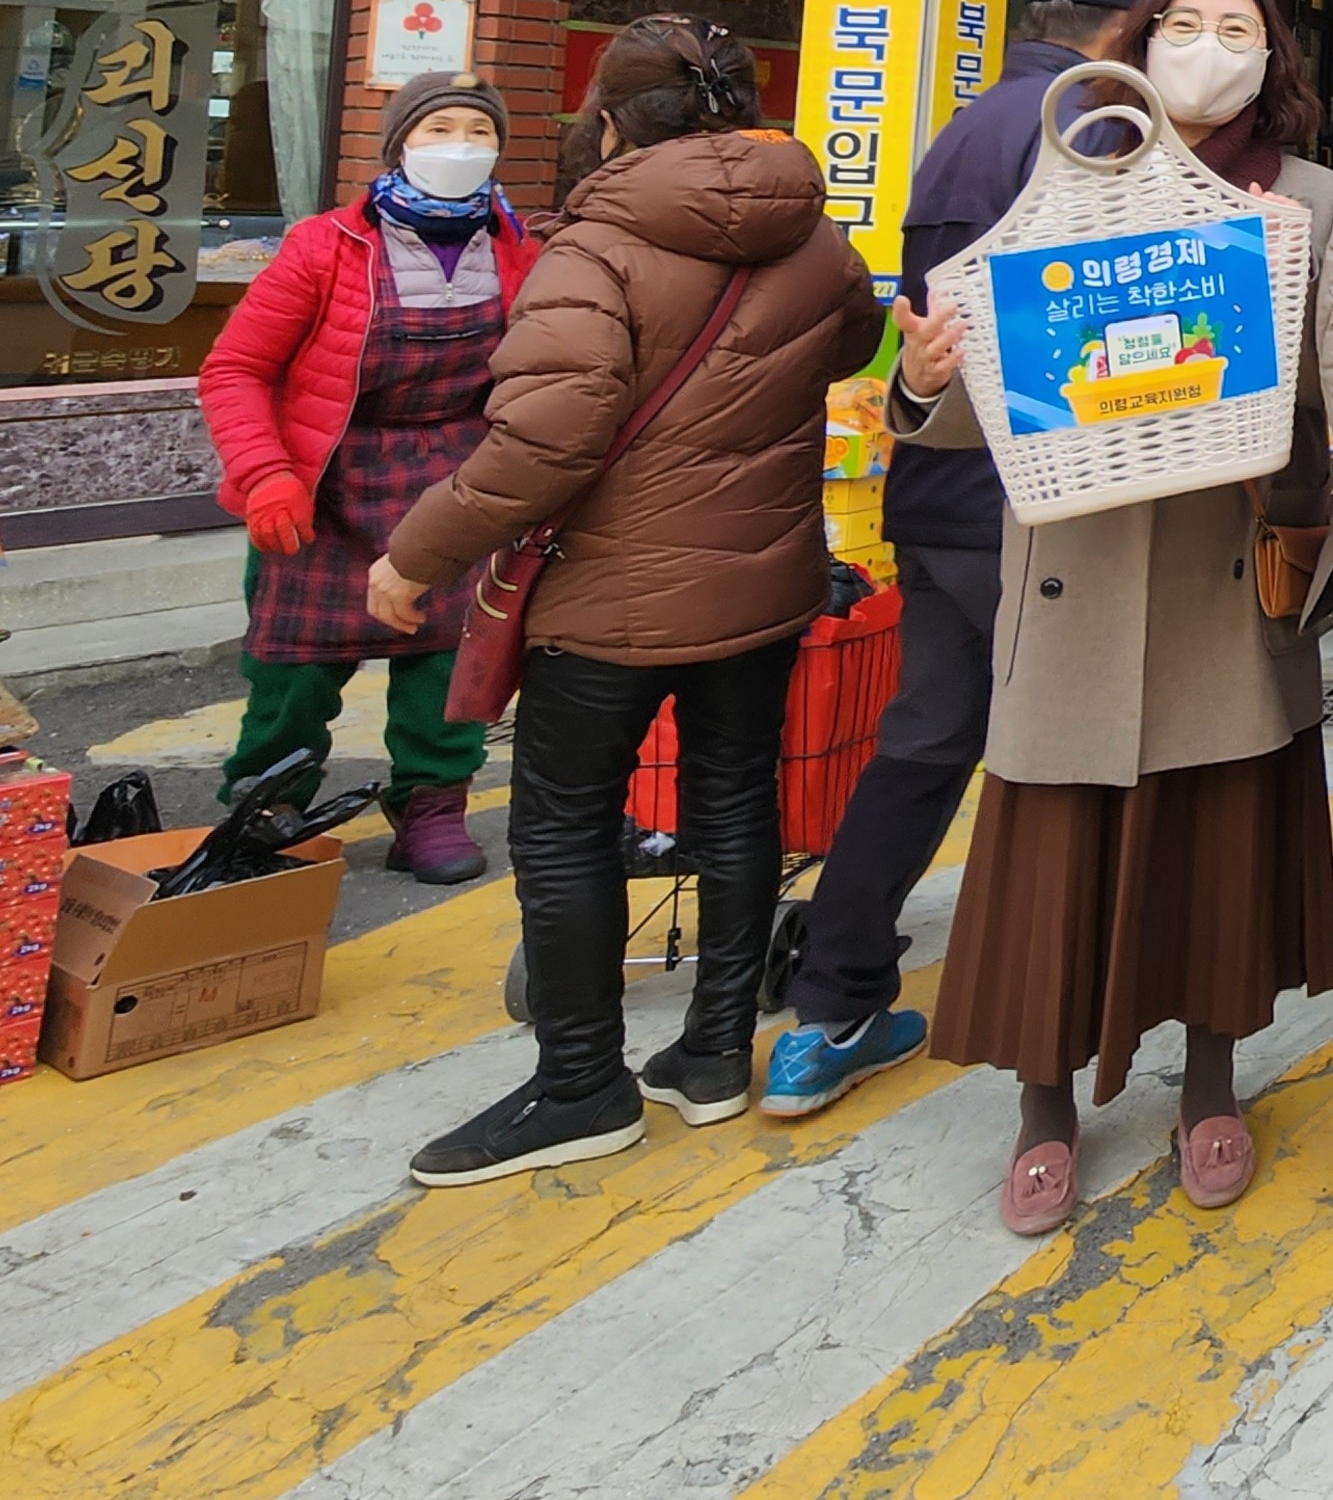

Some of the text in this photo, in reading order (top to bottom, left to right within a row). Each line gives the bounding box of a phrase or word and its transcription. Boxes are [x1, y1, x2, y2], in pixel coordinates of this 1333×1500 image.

[826, 7, 889, 239] 북문입구
[1082, 238, 1206, 288] 의령경제
[1046, 273, 1225, 323] 살리는 착한소비
[1099, 384, 1202, 415] 의령교육지원청
